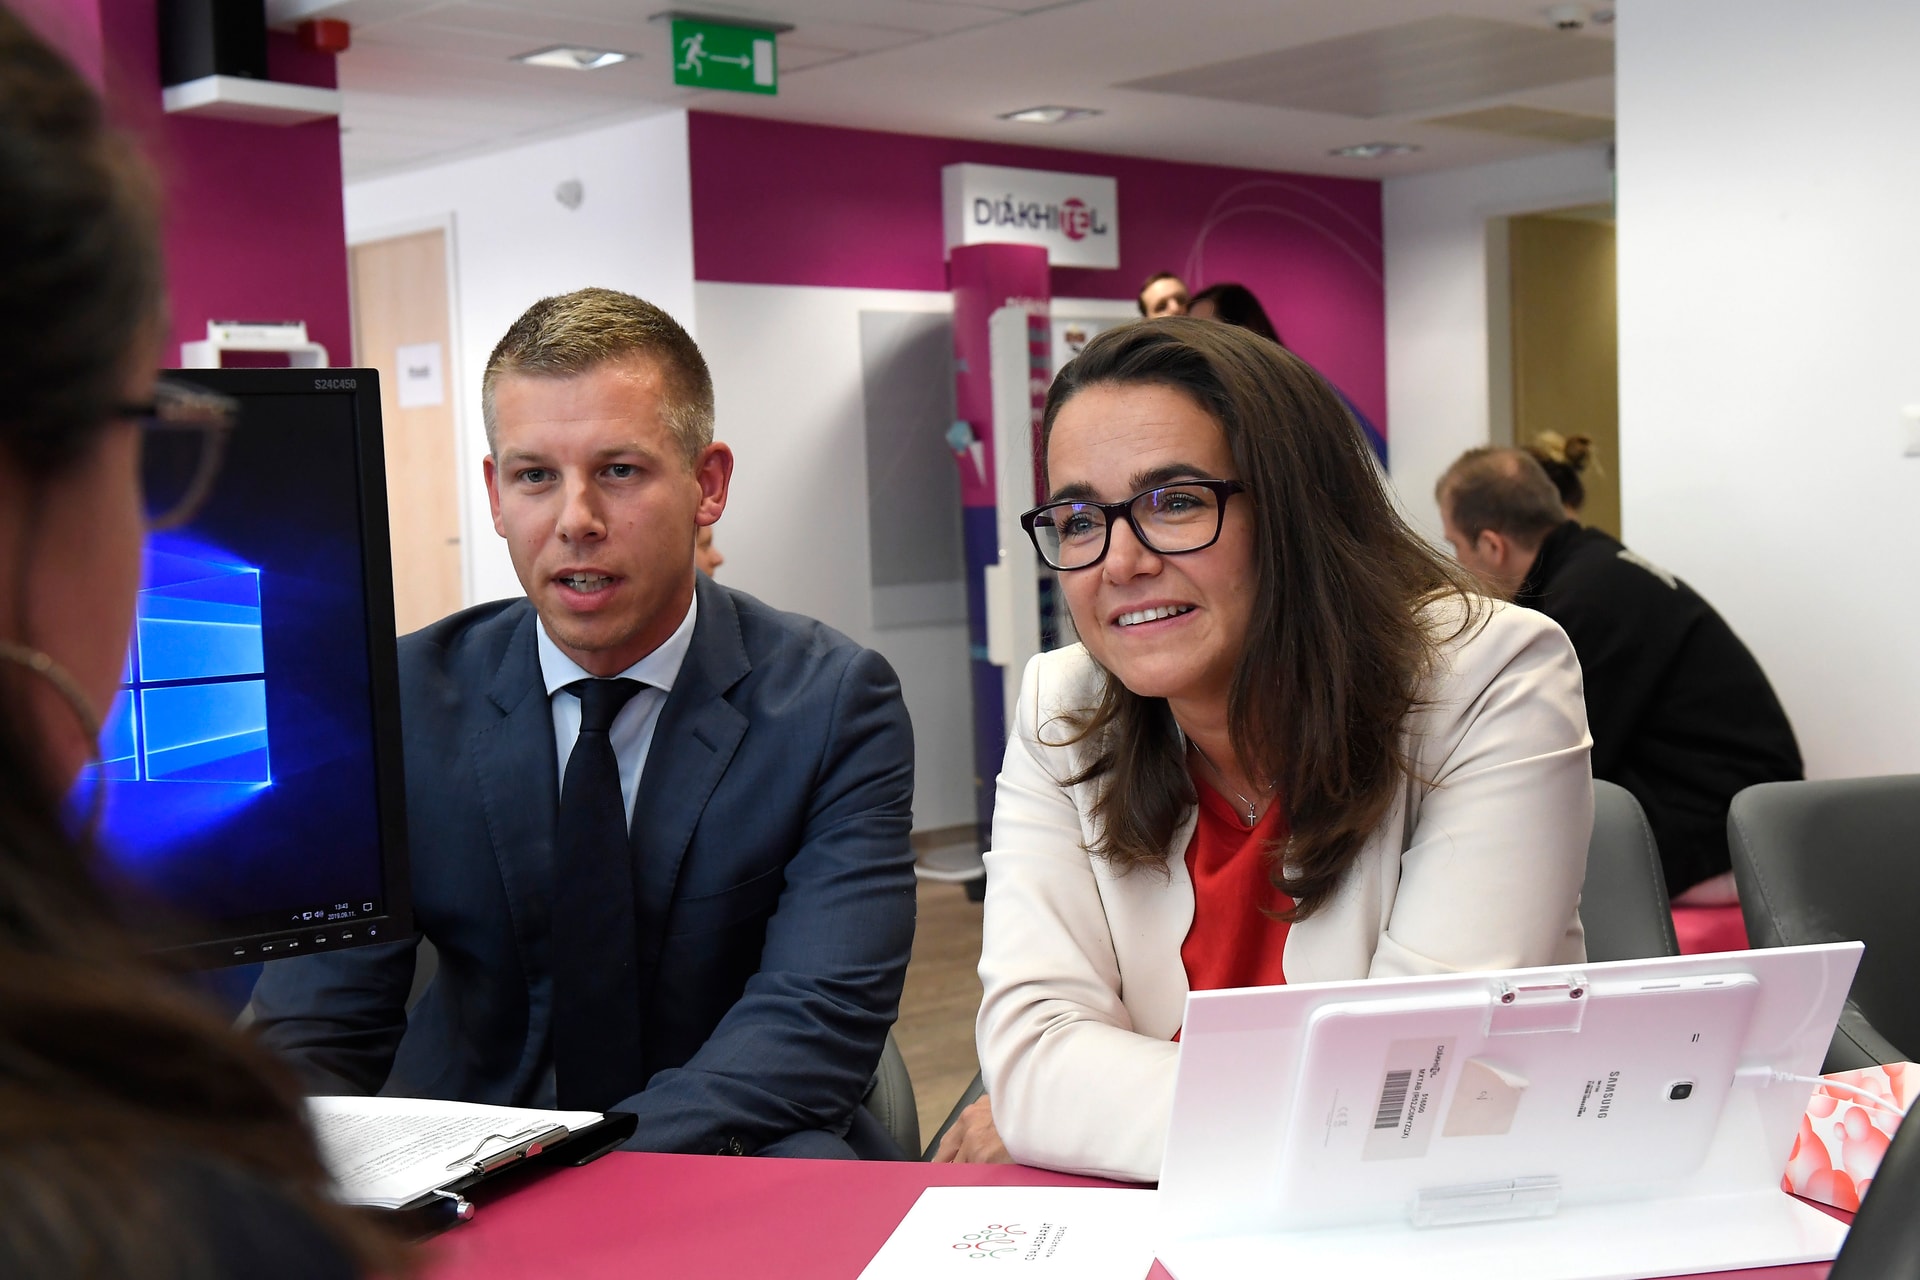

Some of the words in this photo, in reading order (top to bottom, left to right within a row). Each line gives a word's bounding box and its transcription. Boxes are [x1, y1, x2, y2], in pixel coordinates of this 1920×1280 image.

[974, 194, 1107, 237] DIÁKHITEL
[314, 379, 357, 390] S24C450
[334, 902, 348, 910] 13:43
[1597, 1071, 1620, 1119] SAMSUNG
